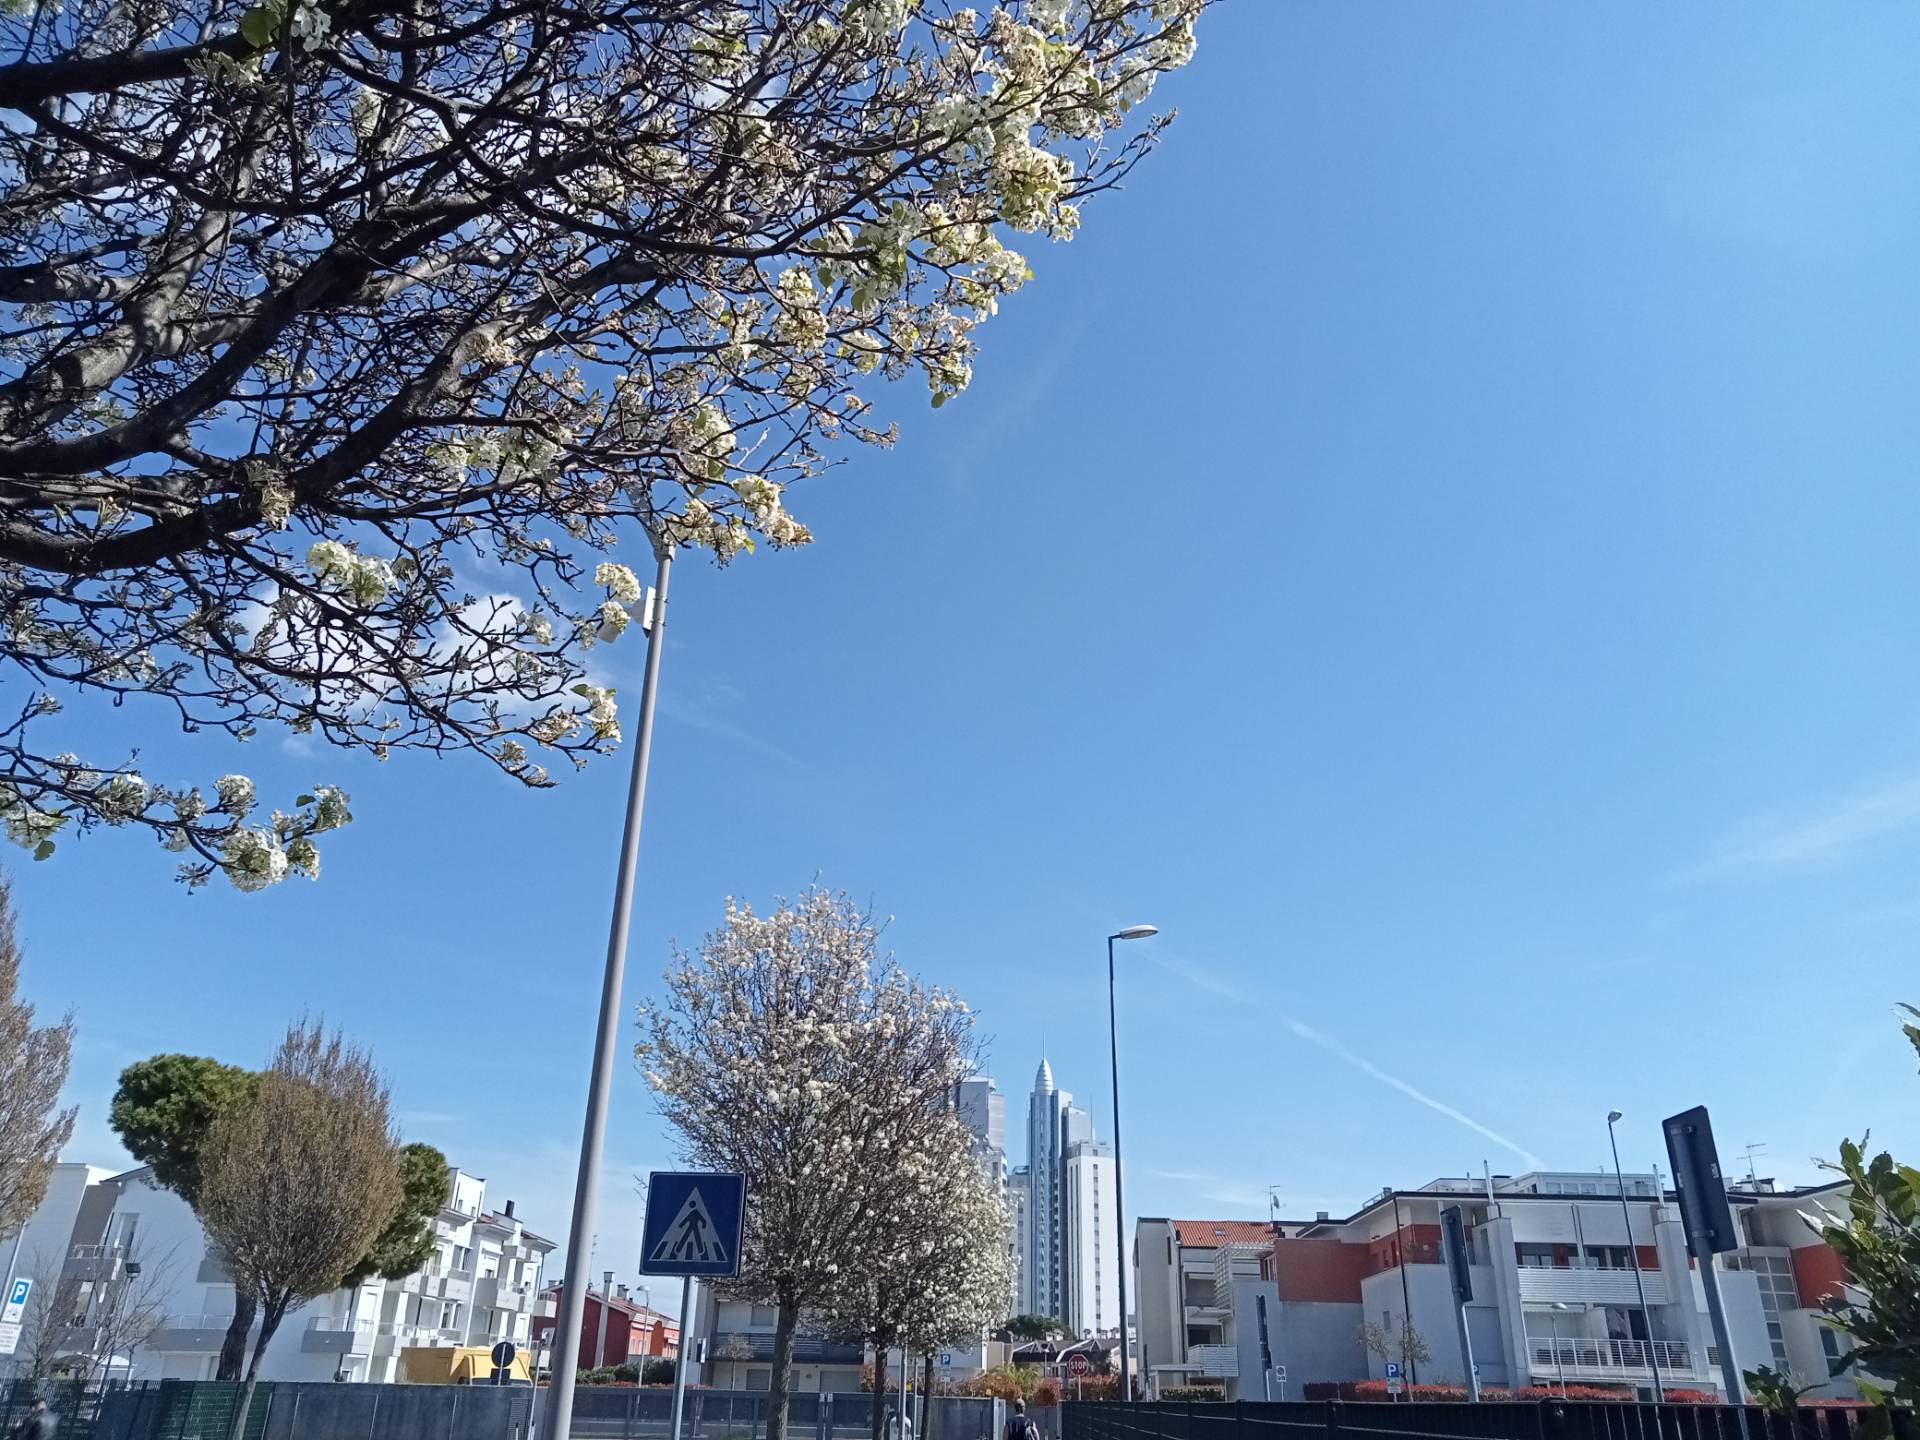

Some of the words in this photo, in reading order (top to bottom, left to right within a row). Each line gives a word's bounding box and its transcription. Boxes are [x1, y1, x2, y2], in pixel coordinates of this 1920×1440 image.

[13, 1284, 25, 1301] P
[943, 1355, 949, 1364] P
[1071, 1361, 1087, 1370] STOP
[1388, 1364, 1396, 1376] P
